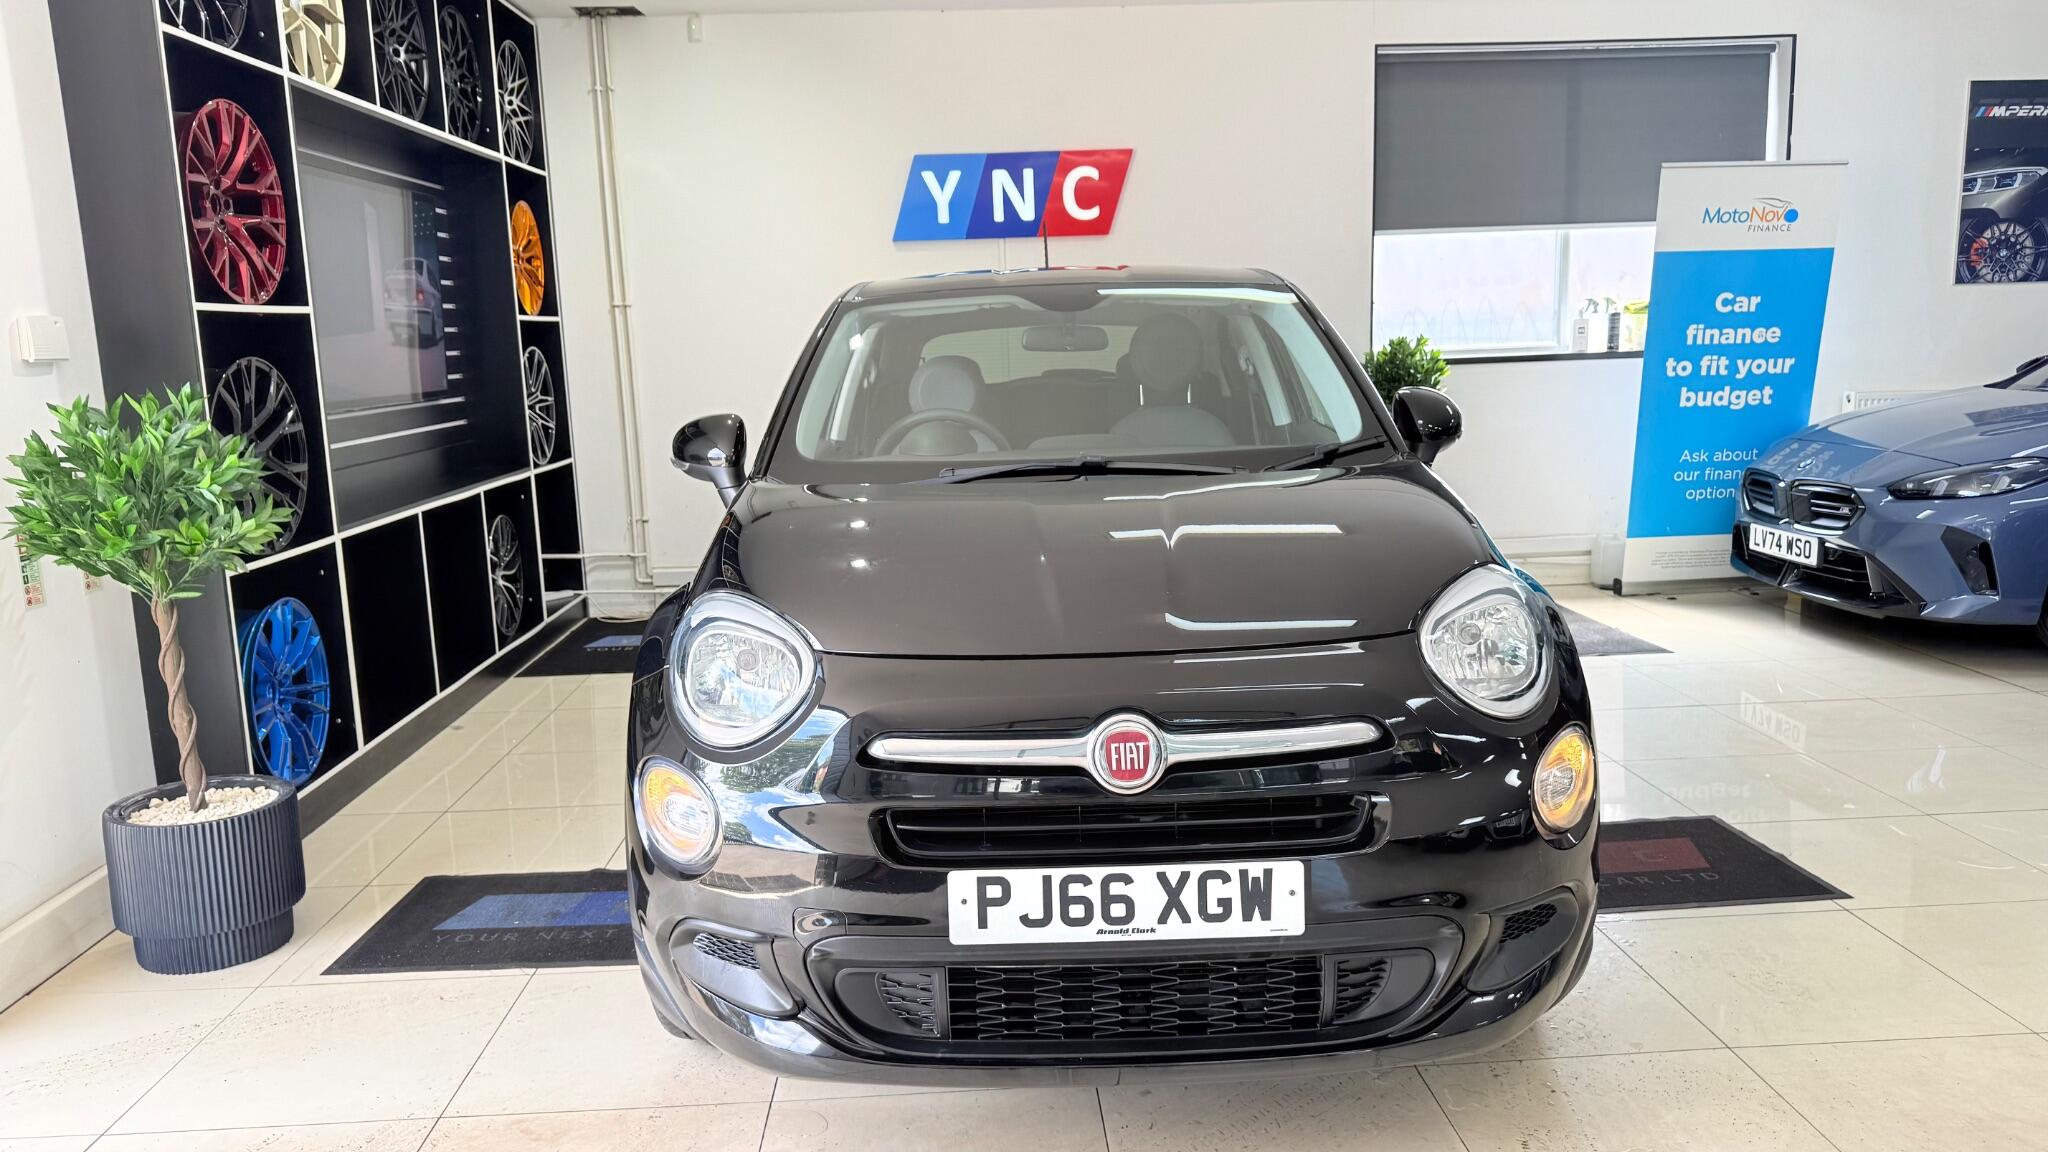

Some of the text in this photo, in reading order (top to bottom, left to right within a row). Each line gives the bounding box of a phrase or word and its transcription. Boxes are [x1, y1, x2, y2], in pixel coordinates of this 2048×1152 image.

[920, 165, 1100, 224] YNC
[1702, 206, 1799, 224] MotoNovo
[1747, 223, 1792, 233] FINANCE
[1715, 292, 1761, 313] Car
[1686, 324, 1781, 345] finance
[1666, 355, 1796, 379] to fit your
[1679, 386, 1773, 410] budget
[1680, 448, 1758, 463] Ask about
[1674, 467, 1744, 482] our finan
[1754, 528, 1812, 559] LV74 WSO
[1110, 741, 1149, 771] FIAT
[1664, 872, 1719, 882] LTD
[976, 868, 1273, 930] PJ66 XGW
[436, 928, 618, 943] YOUR NEXT
